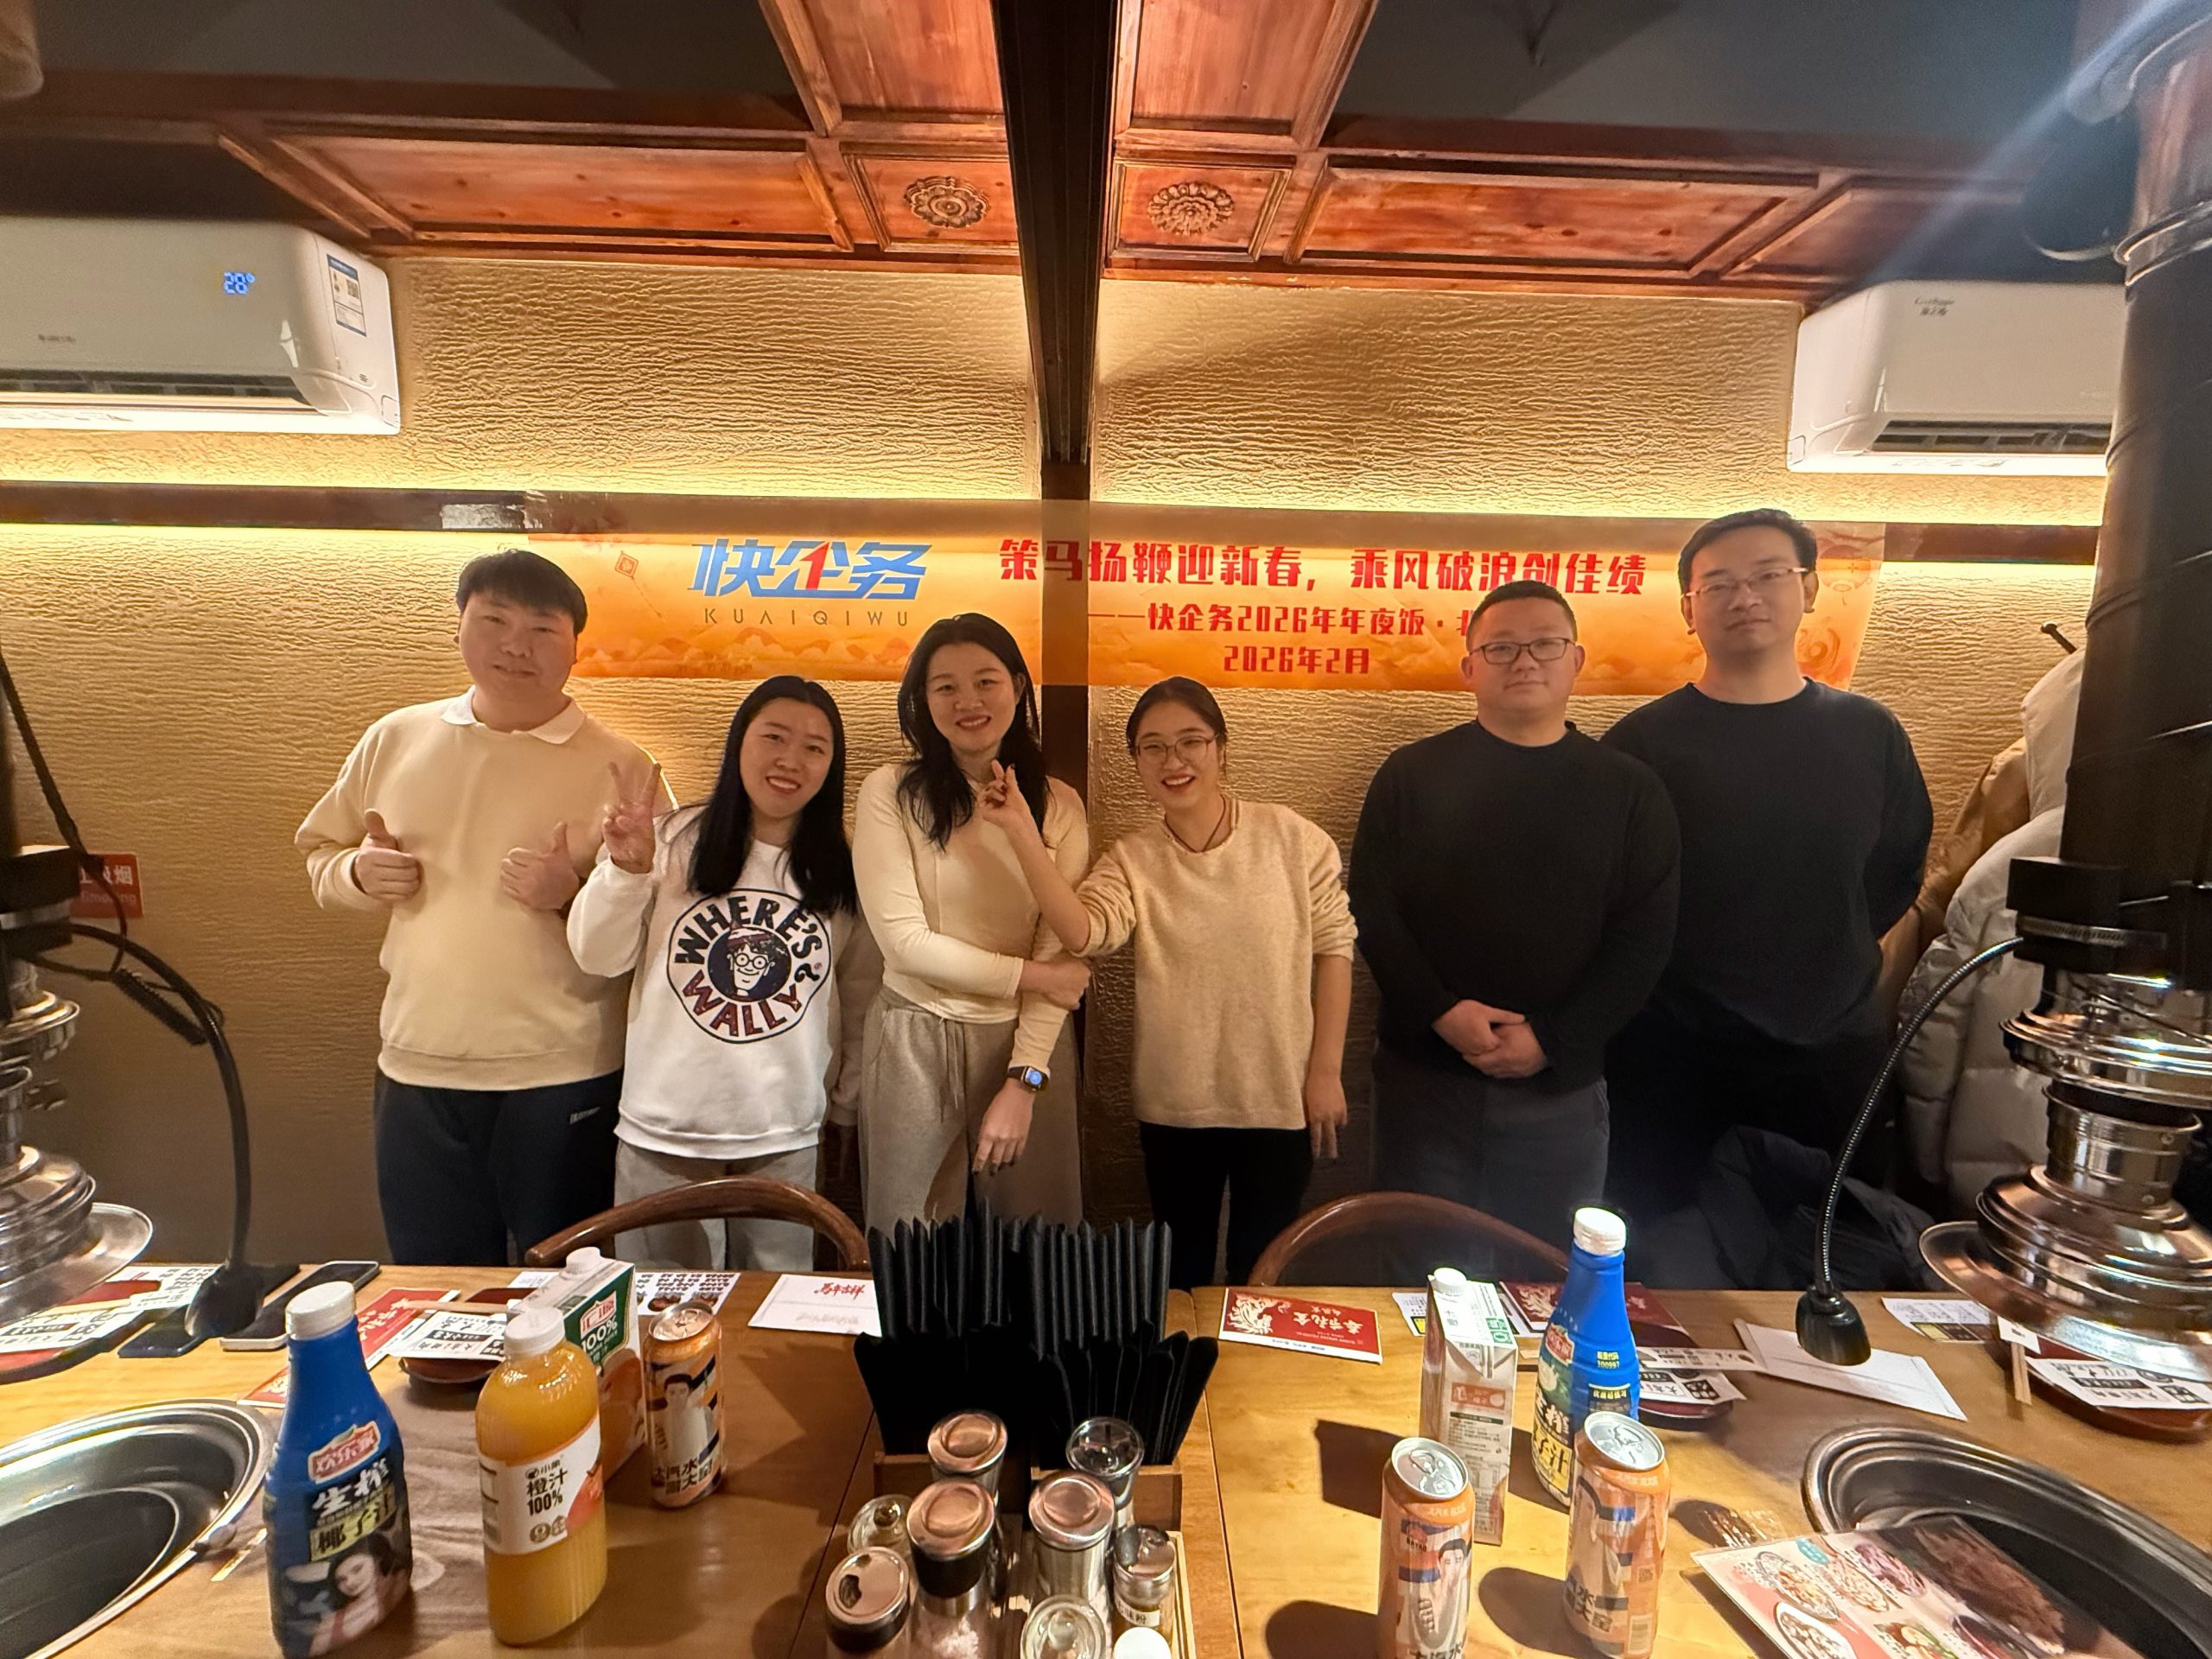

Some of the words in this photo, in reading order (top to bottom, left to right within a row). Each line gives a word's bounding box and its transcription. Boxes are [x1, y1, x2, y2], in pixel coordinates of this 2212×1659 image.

[688, 538, 931, 600] 快企务
[1224, 645, 1370, 675] 2026年2月
[674, 895, 823, 965] WHERE'S
[527, 1467, 569, 1497] 橙汁
[527, 1487, 563, 1516] 100%
